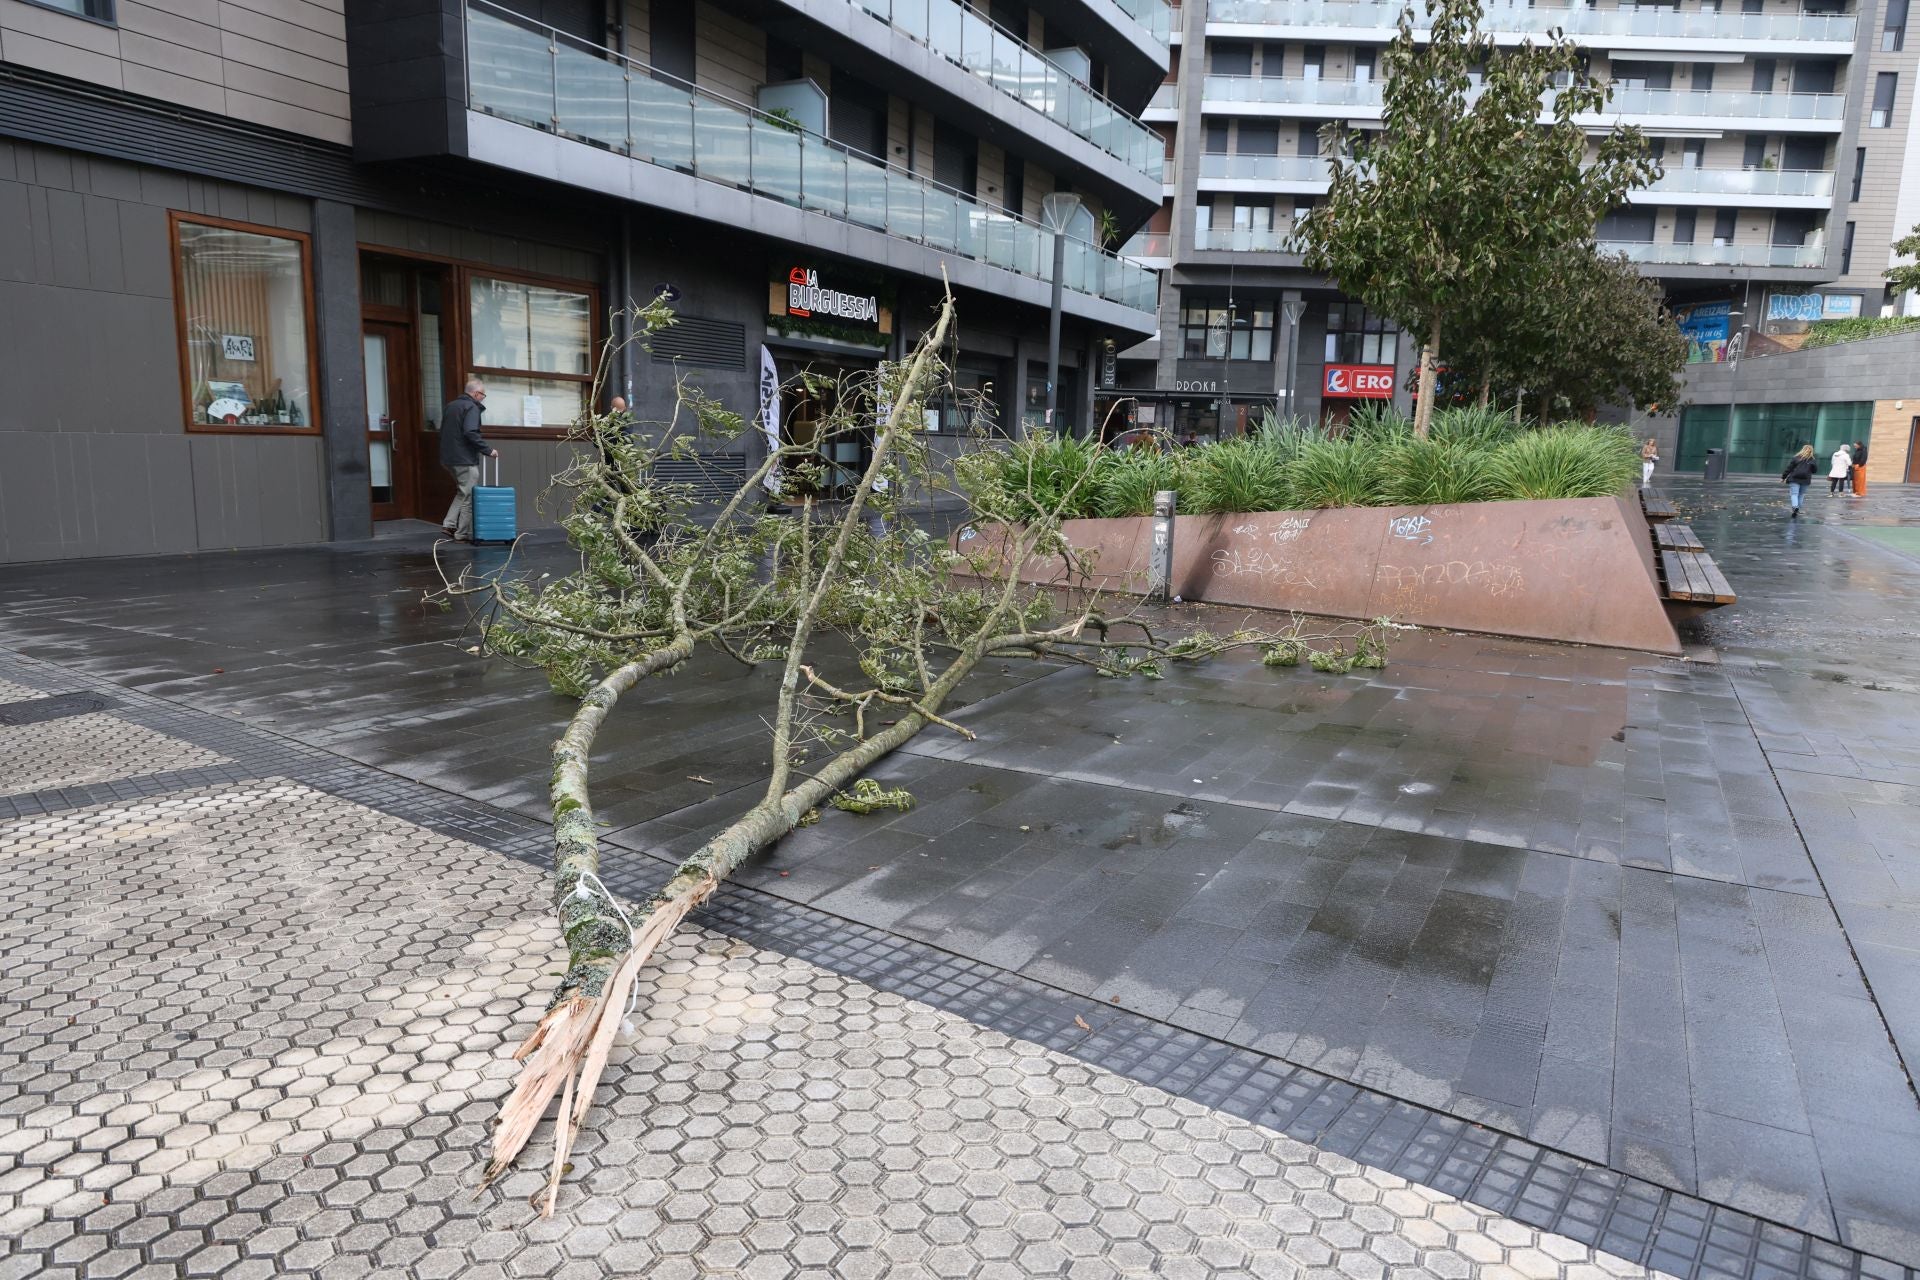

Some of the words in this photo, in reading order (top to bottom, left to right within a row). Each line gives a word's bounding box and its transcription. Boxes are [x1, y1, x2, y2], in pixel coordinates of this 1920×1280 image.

[806, 268, 818, 287] LA
[790, 283, 878, 322] BURGUESSIA
[1104, 344, 1116, 385] RICCIO
